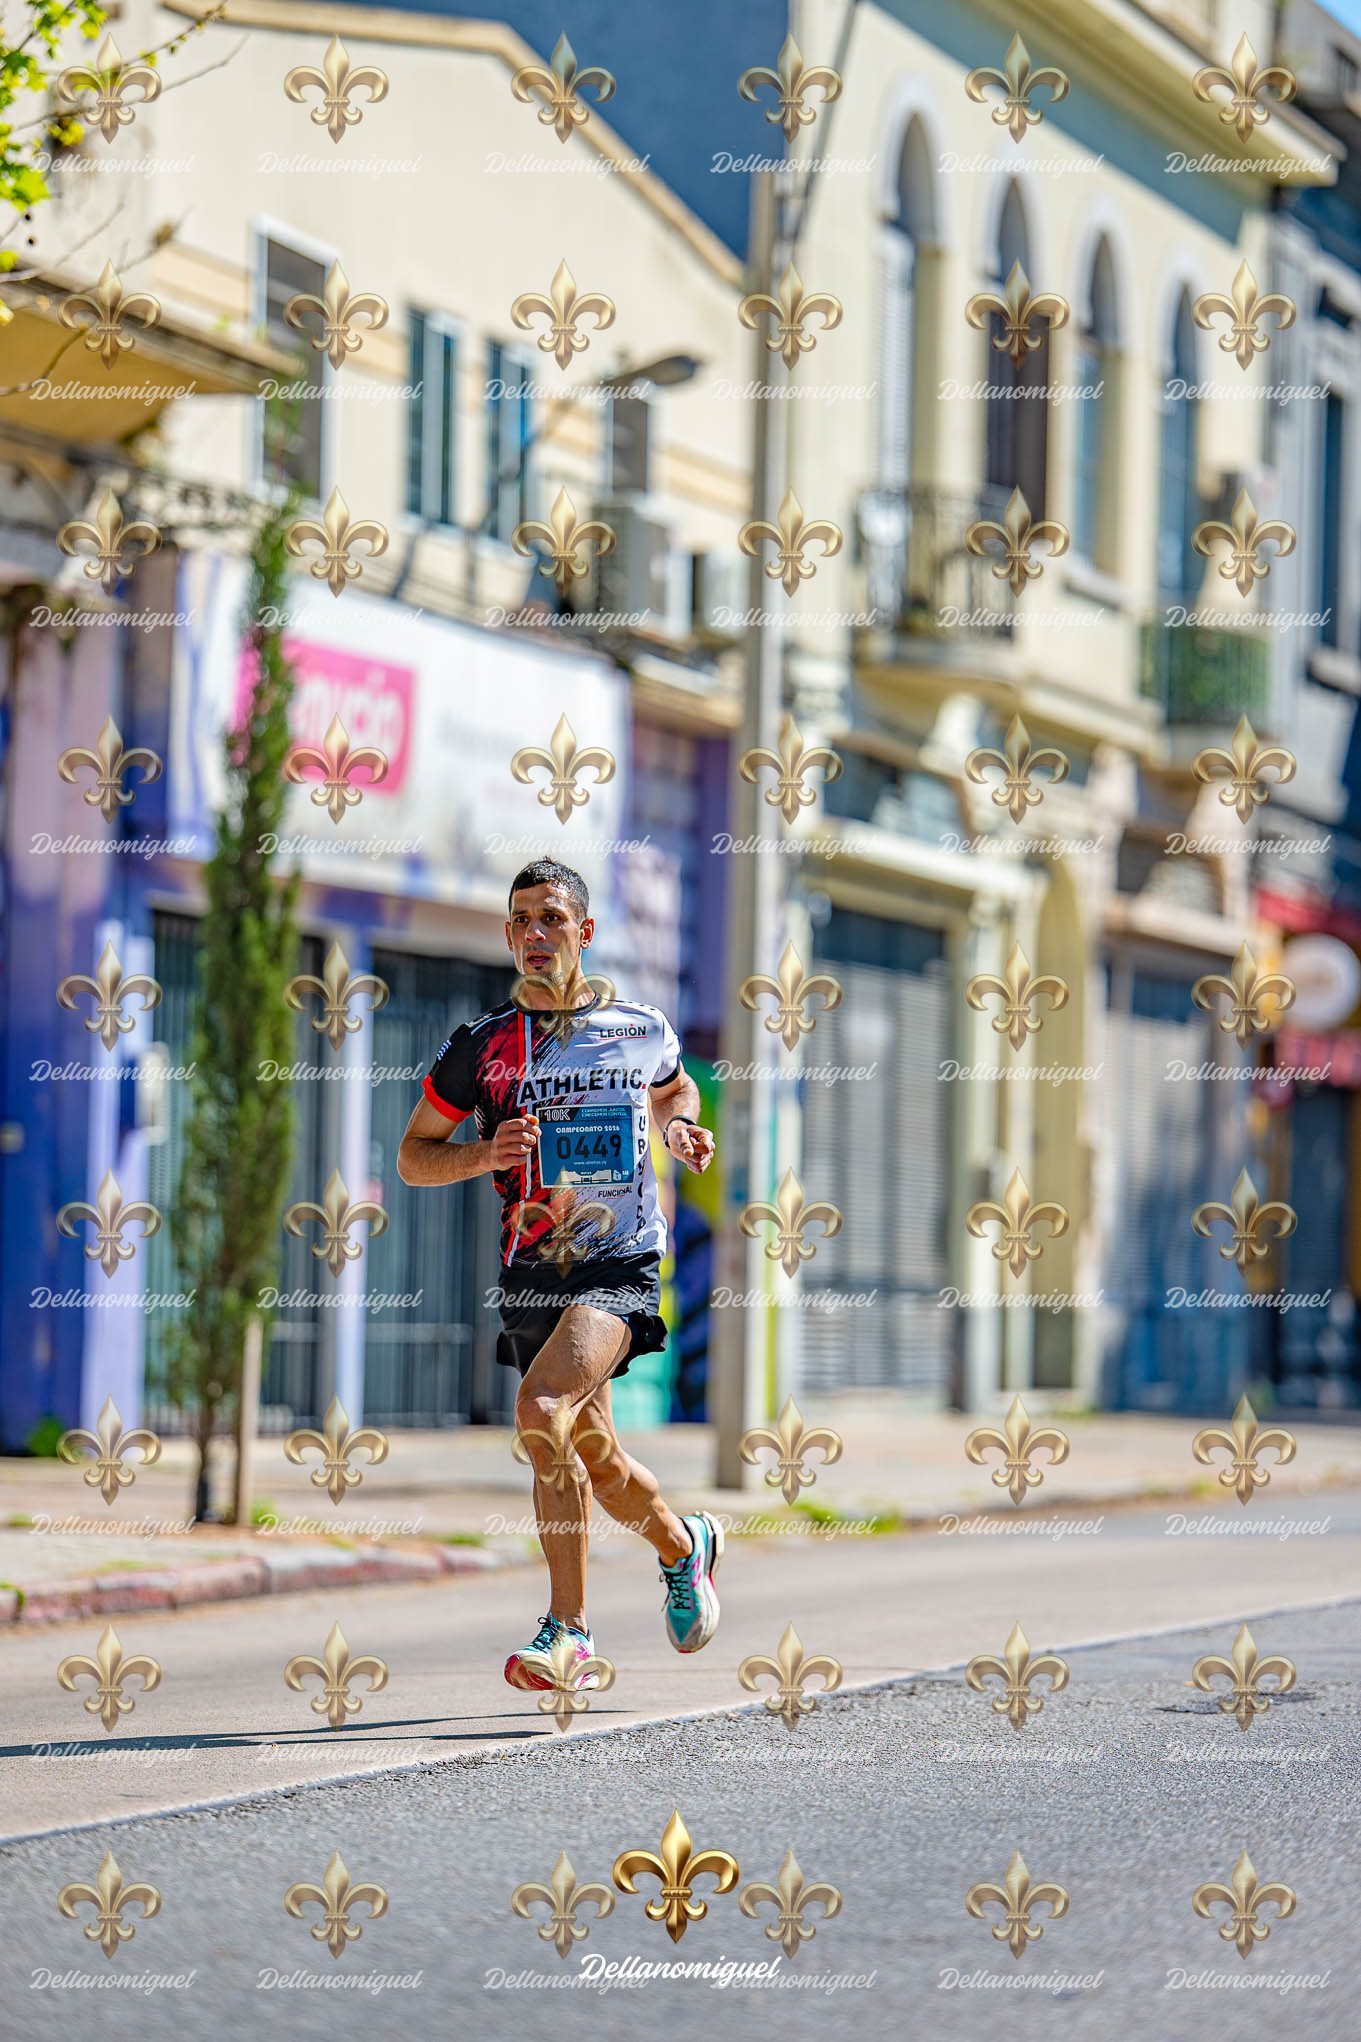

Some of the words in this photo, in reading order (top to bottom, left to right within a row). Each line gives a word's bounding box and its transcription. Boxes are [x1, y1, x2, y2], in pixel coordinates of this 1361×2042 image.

[544, 1108, 571, 1121] 10K
[555, 1125, 603, 1134] CAMPEONATO
[556, 1134, 622, 1160] 0449
